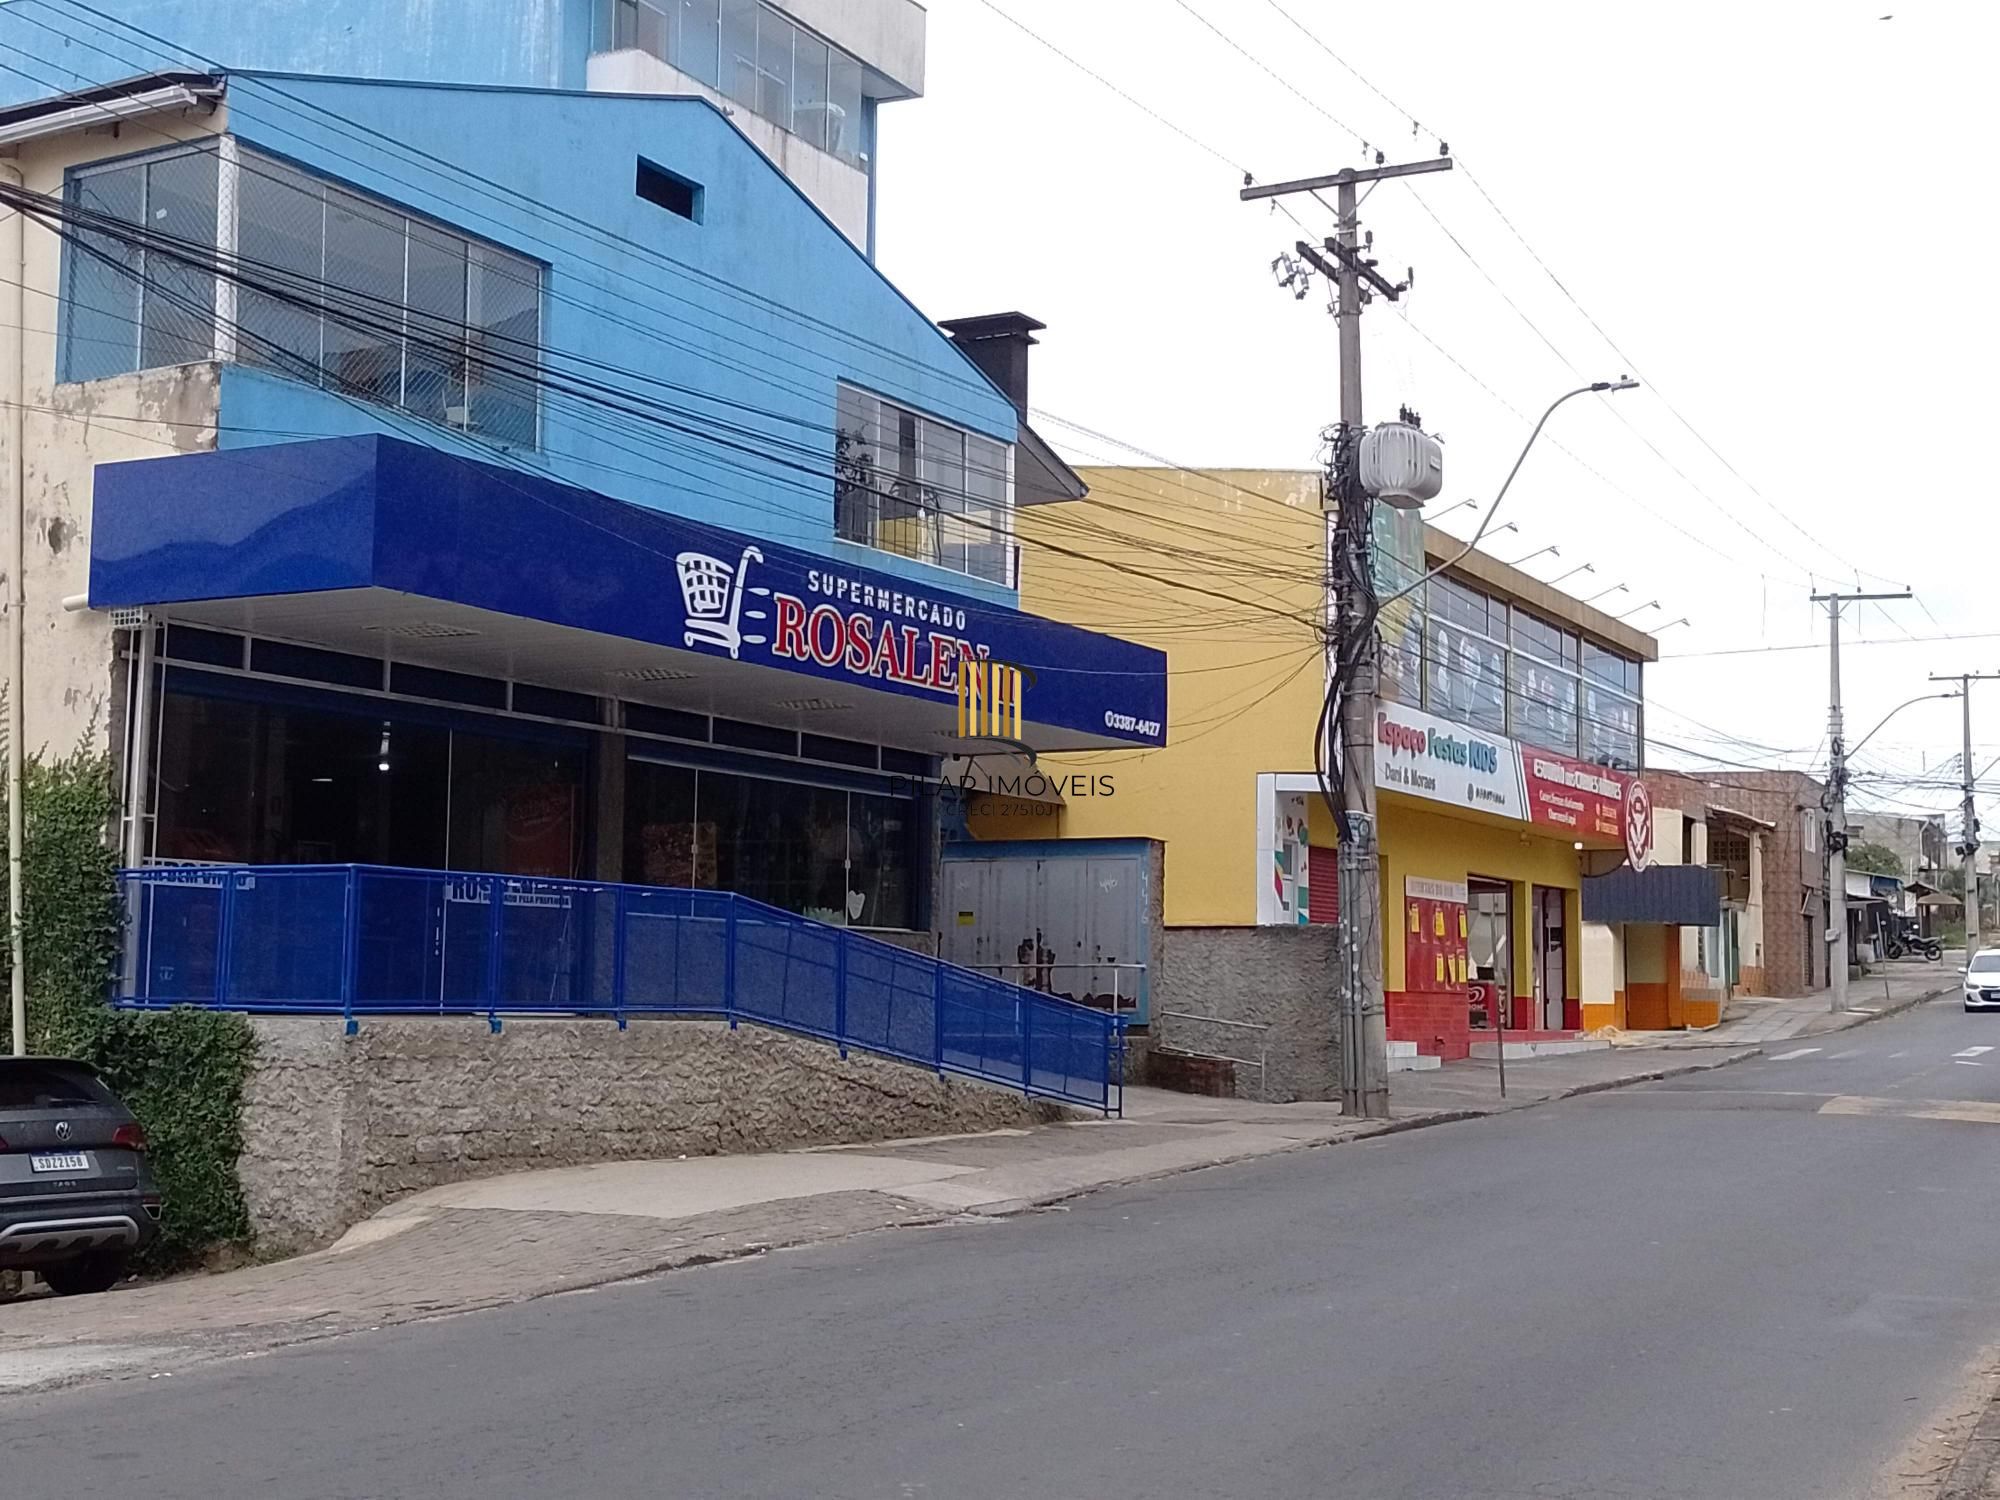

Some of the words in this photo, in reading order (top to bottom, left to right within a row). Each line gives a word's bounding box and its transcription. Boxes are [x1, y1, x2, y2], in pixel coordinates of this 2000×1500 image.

[807, 570, 967, 630] SUPERMERCADO
[772, 592, 990, 702] ROSALEN
[1468, 740, 1498, 774] KIDS
